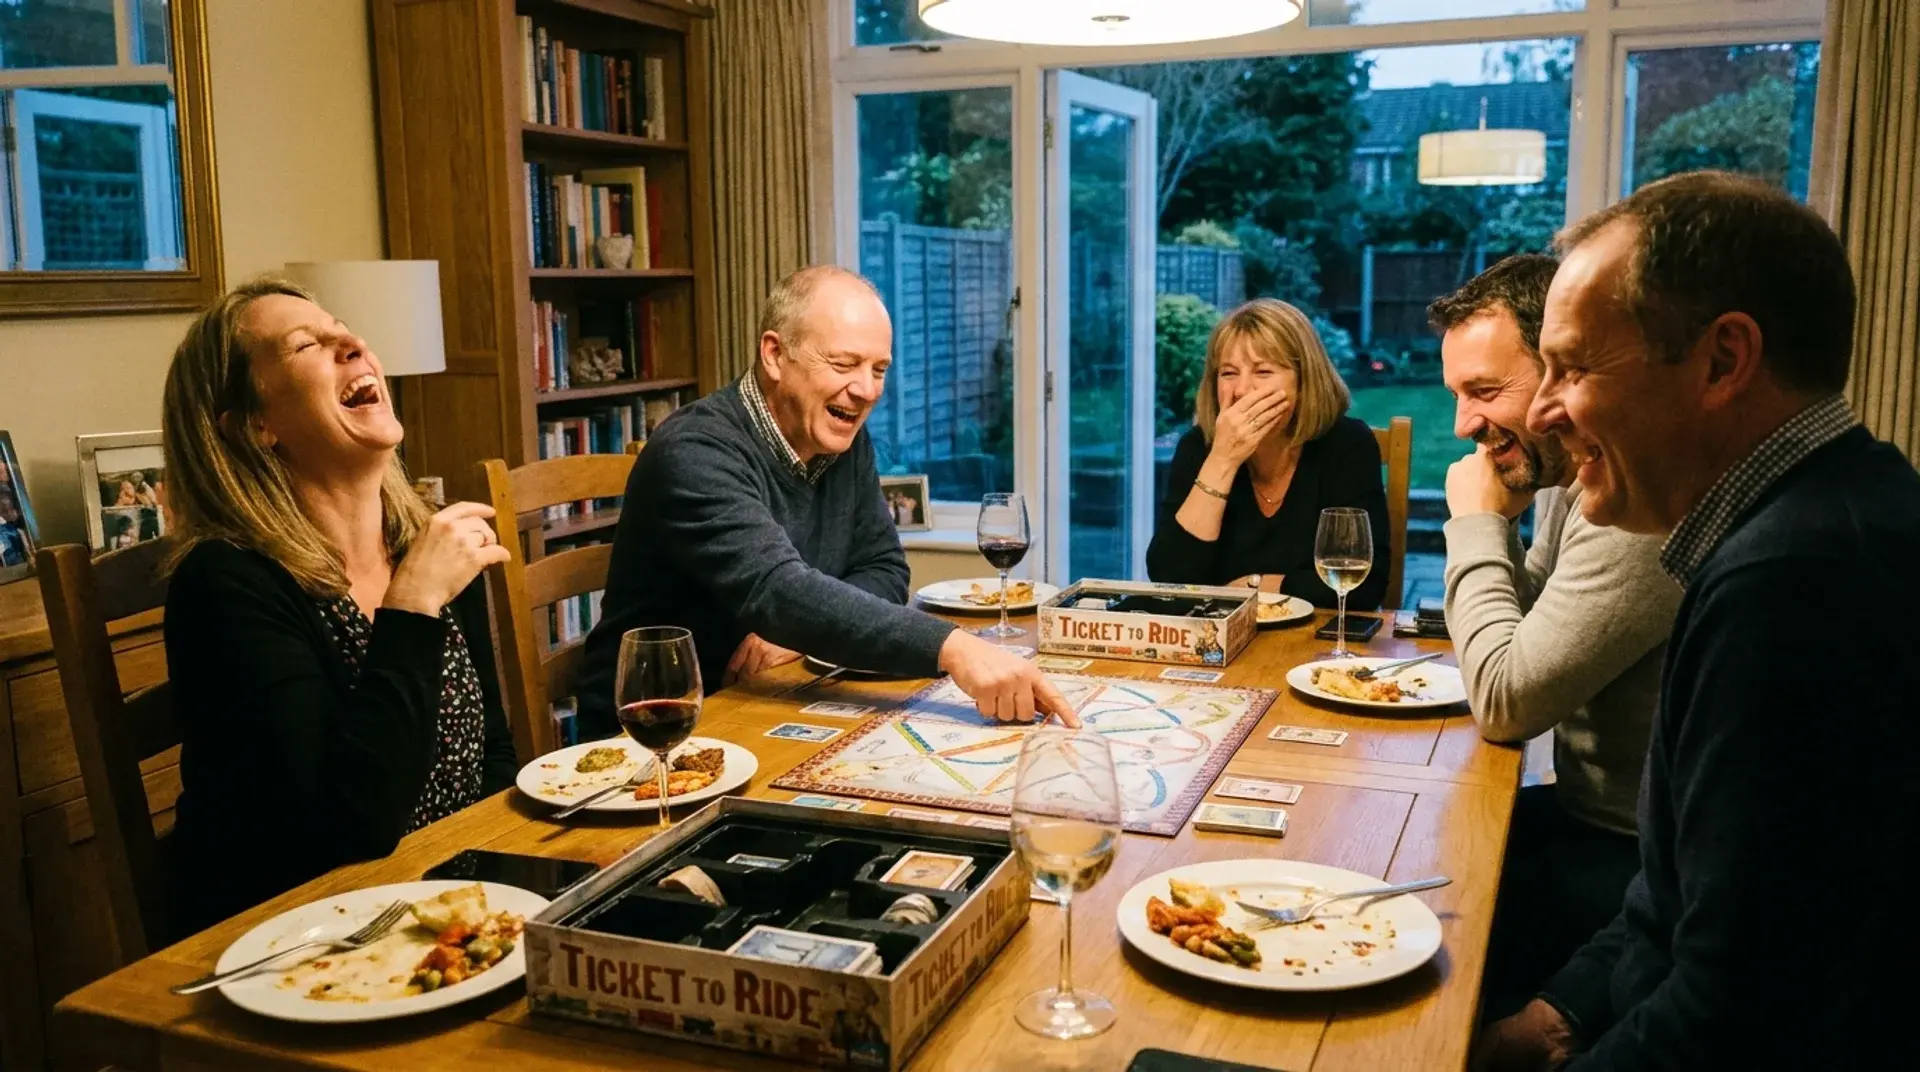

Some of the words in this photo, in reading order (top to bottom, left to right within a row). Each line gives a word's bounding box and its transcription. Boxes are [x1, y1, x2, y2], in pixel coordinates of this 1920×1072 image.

[1058, 616, 1124, 641] TICKET
[1128, 628, 1144, 640] TO
[1148, 622, 1191, 648] RIDE
[559, 943, 685, 1004] TICKET
[692, 977, 725, 1006] TO
[734, 969, 821, 1029] RIDE
[909, 929, 969, 1018] TICKET
